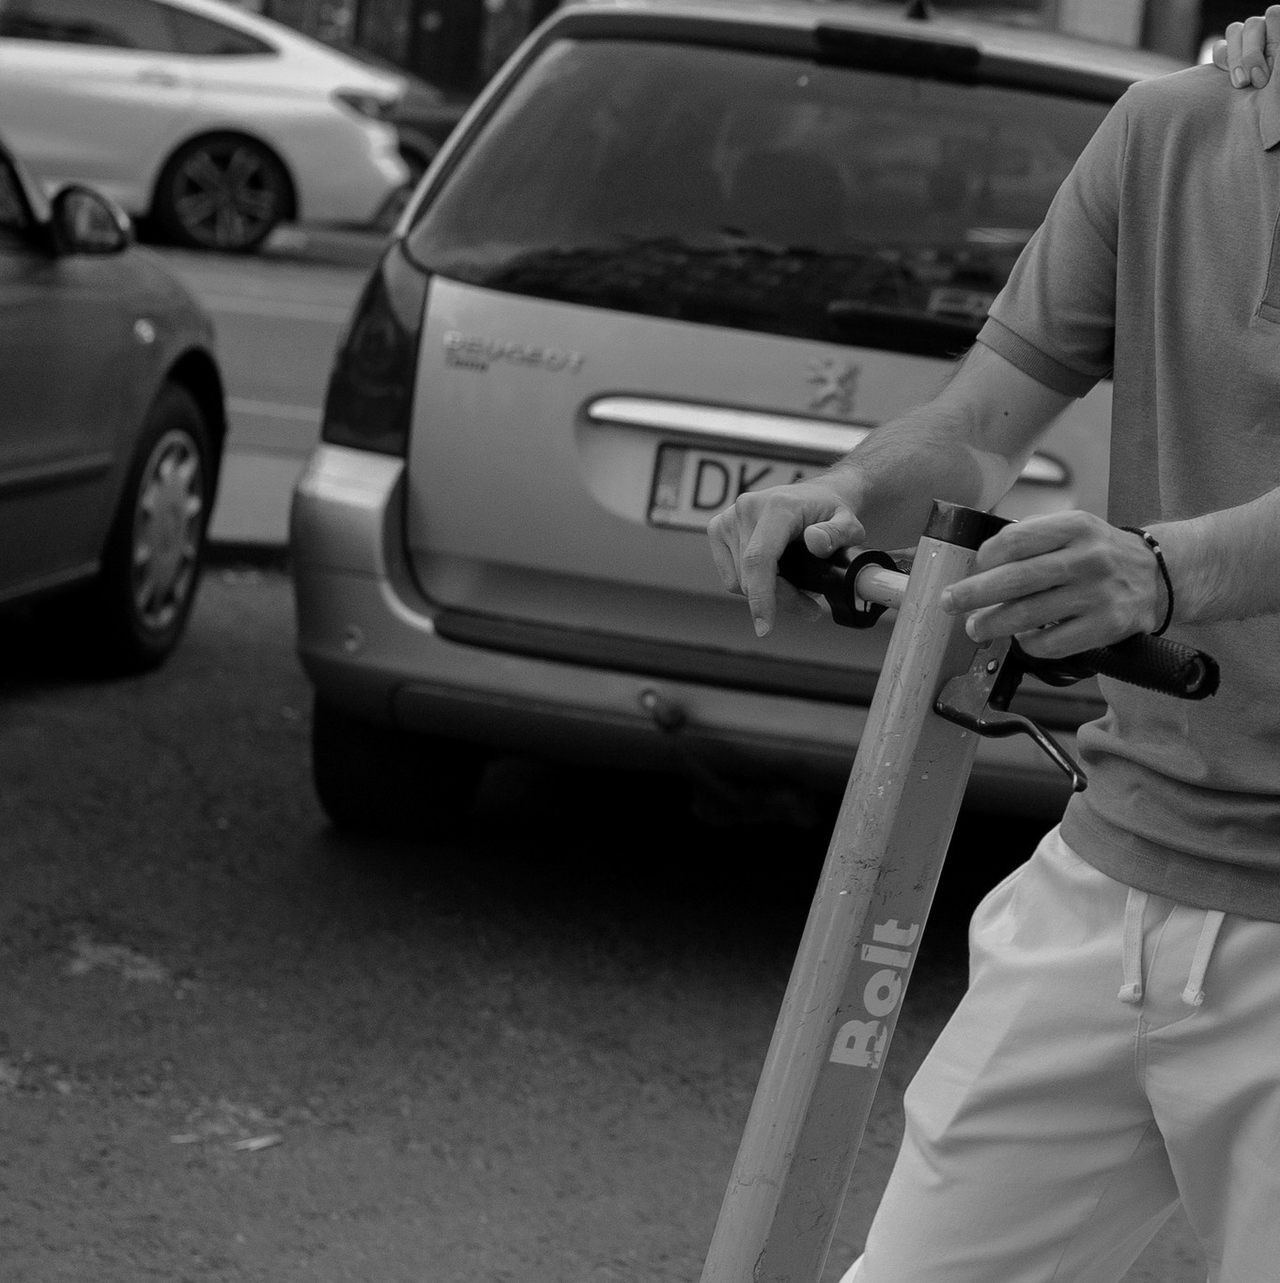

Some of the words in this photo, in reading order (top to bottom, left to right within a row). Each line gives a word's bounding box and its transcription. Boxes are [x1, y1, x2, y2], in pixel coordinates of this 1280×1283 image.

[443, 330, 587, 374] PEUGEOT
[692, 458, 803, 510] DK
[828, 918, 920, 1070] Bolt
